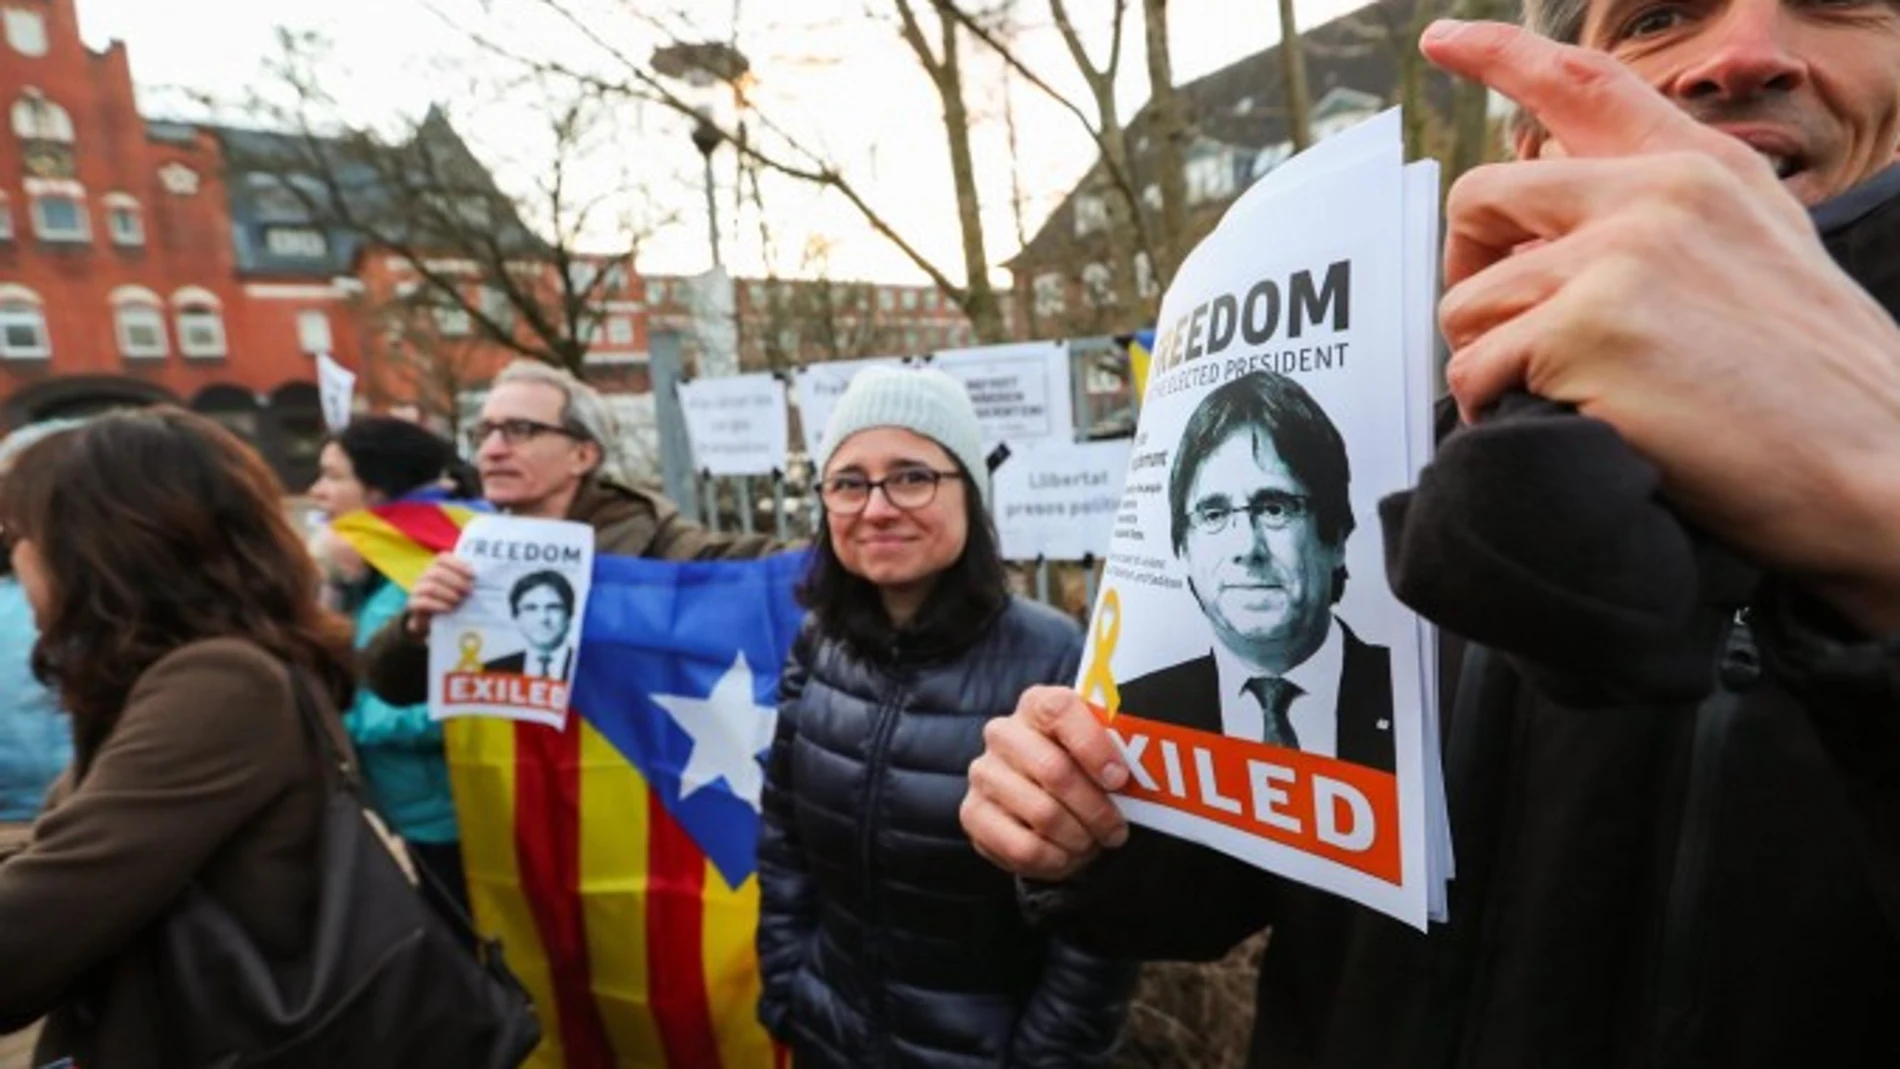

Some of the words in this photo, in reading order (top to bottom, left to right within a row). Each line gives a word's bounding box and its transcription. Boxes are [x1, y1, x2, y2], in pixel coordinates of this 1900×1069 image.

[1156, 259, 1350, 378] REEDOM
[1224, 343, 1349, 381] PRESIDENT
[1106, 727, 1377, 852] XILED
